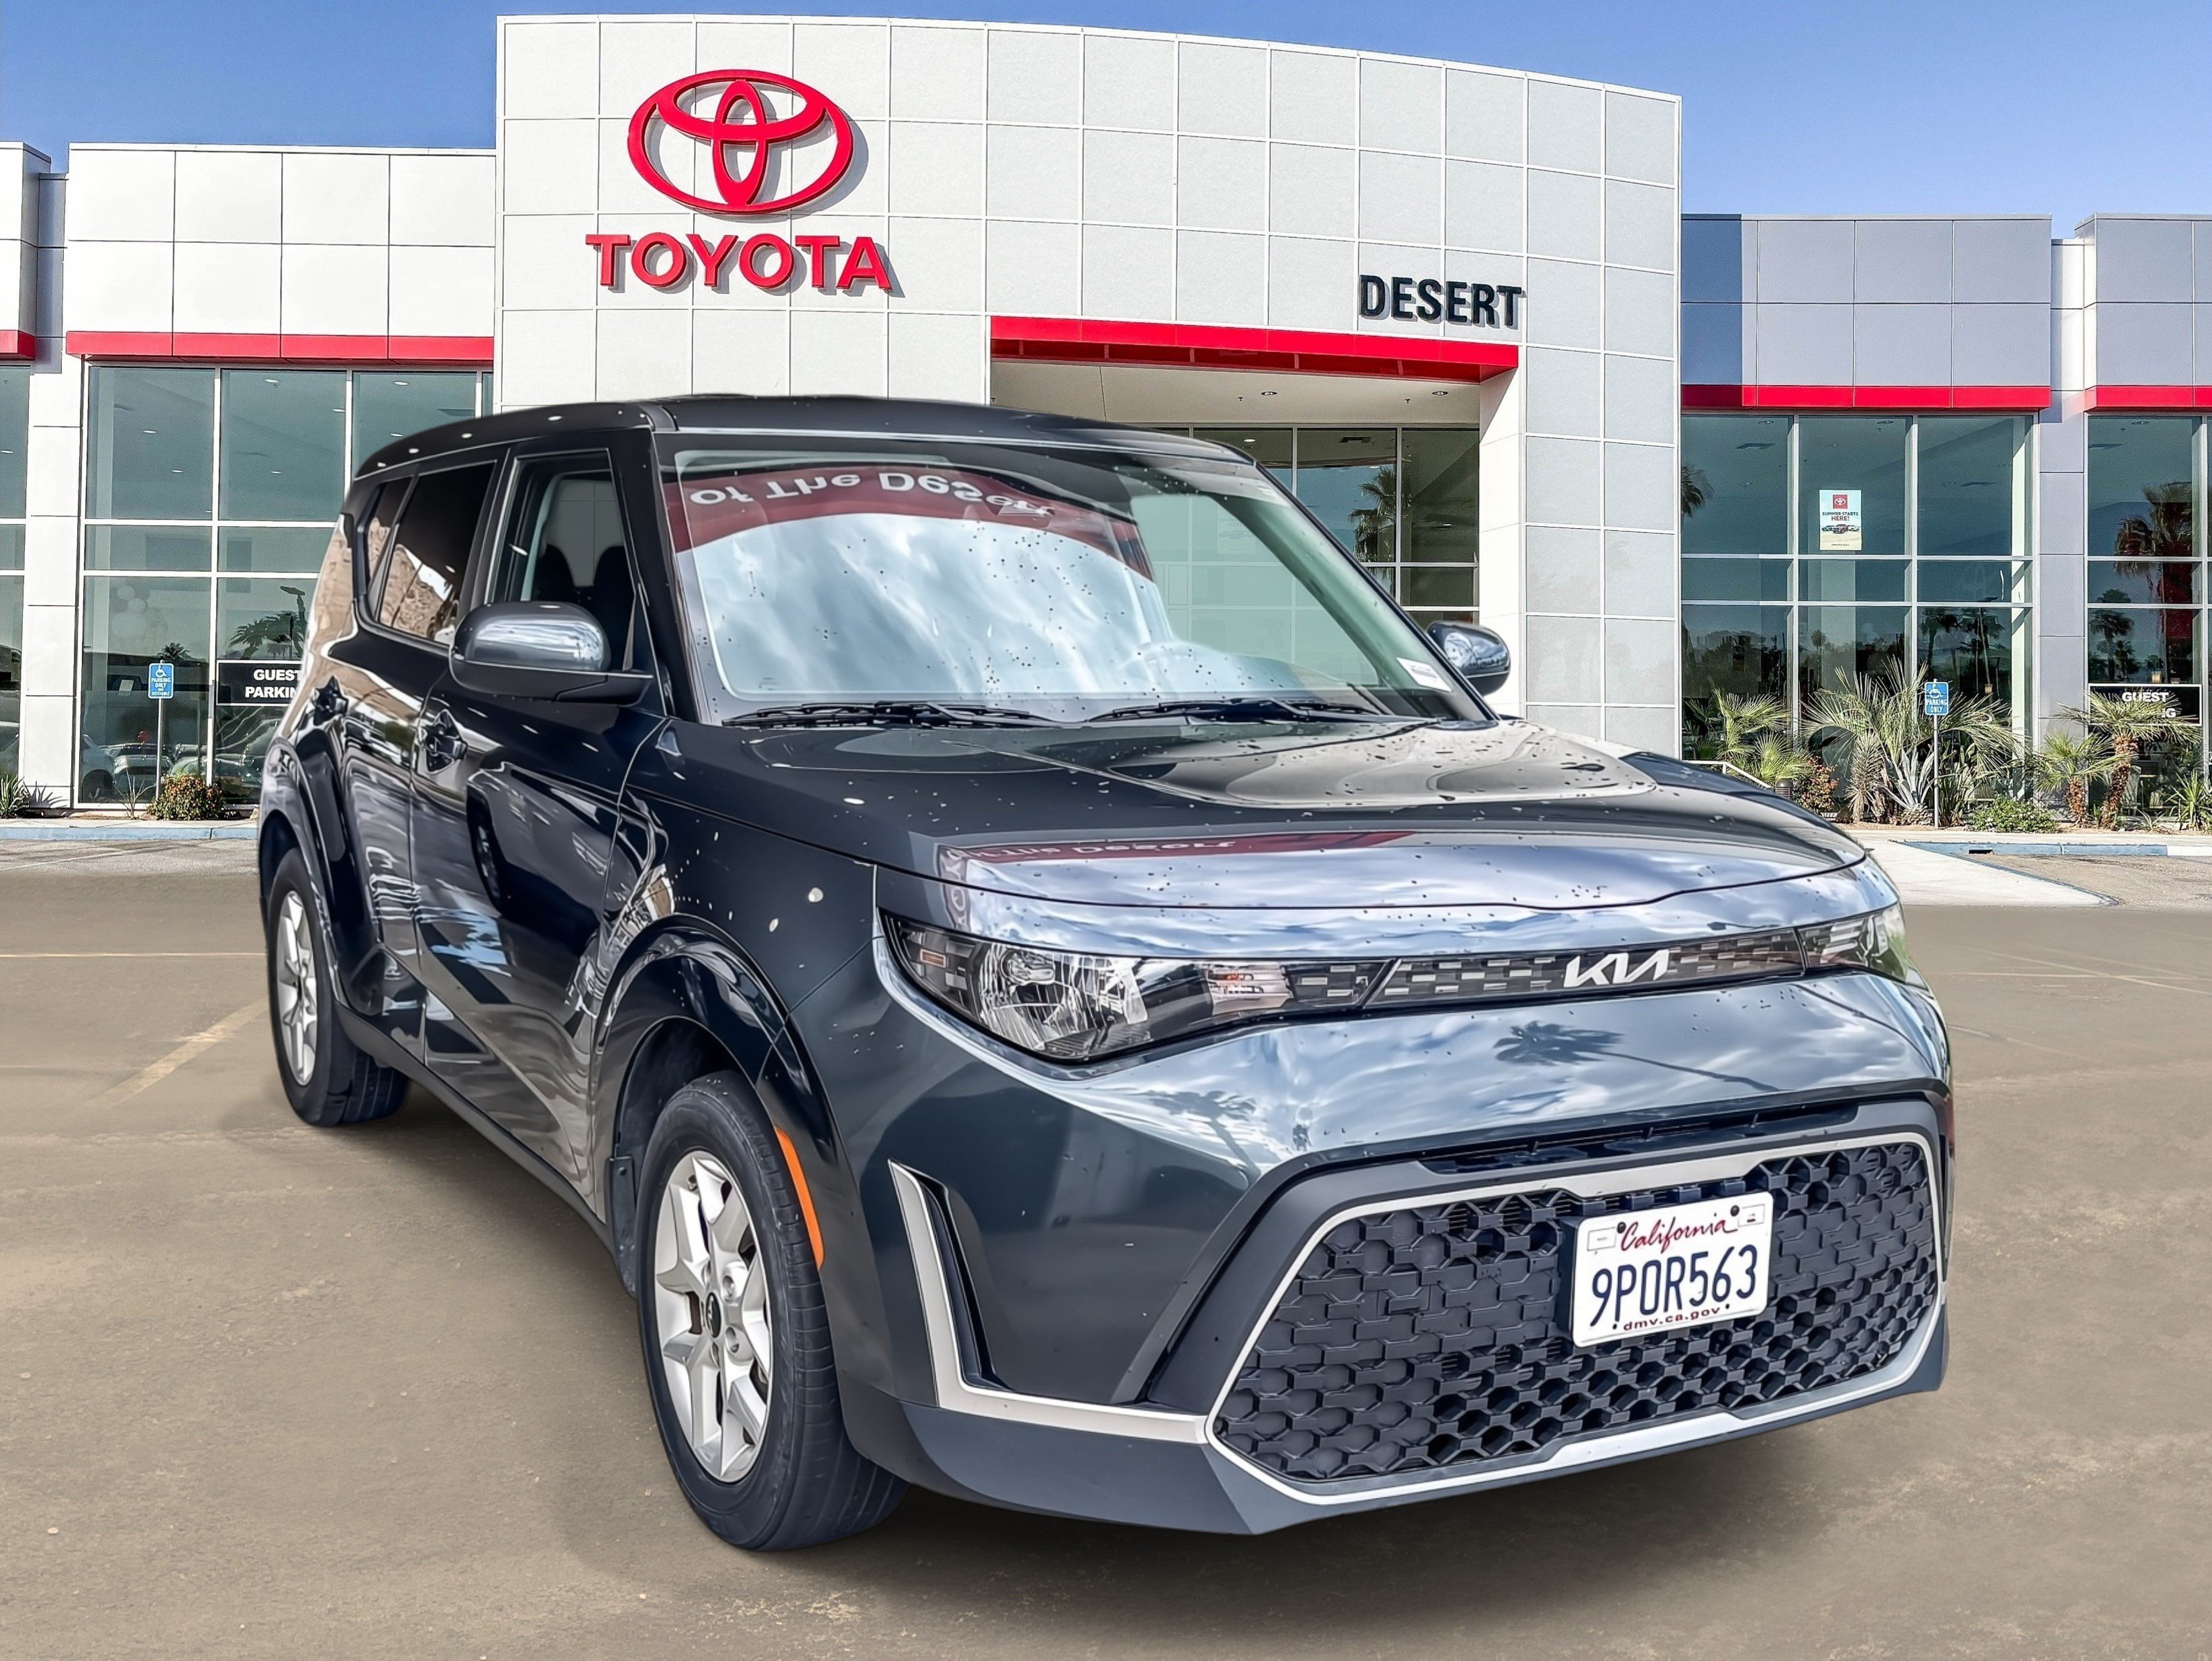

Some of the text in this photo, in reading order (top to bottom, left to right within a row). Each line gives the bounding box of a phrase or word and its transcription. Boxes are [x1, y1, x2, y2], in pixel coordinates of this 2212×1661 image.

[586, 232, 893, 289] TOYOTA
[1359, 274, 1522, 327] DESERT
[254, 668, 301, 681] GUEST
[245, 686, 297, 698] PARKIN
[2121, 691, 2170, 703] GUEST
[1563, 949, 1670, 988] KIA
[1620, 1215, 1738, 1254] California
[1623, 1307, 1720, 1331] dmv.ca.gov
